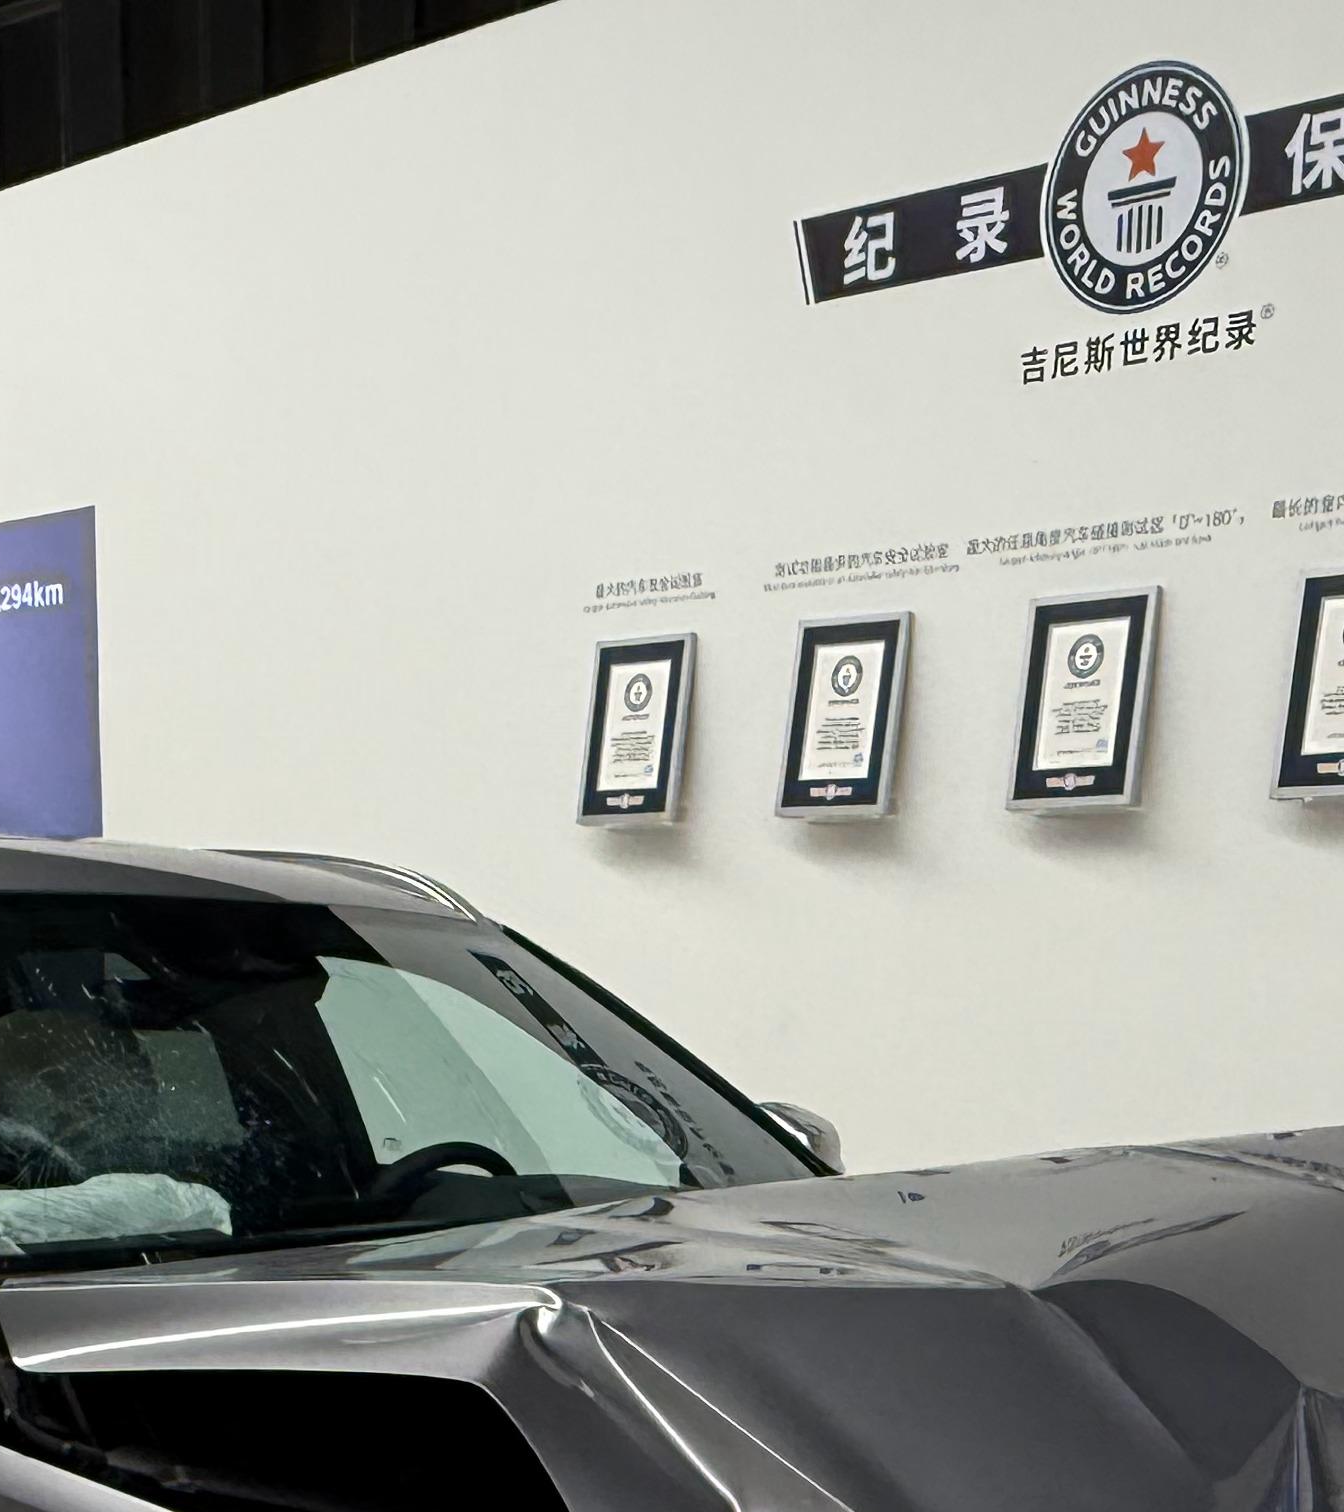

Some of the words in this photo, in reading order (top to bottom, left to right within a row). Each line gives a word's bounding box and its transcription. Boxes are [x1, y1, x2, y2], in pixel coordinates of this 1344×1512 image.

[1075, 76, 1218, 157] GUINNESS
[1056, 188, 1116, 294] WORLD
[1125, 155, 1230, 299] RECORDS
